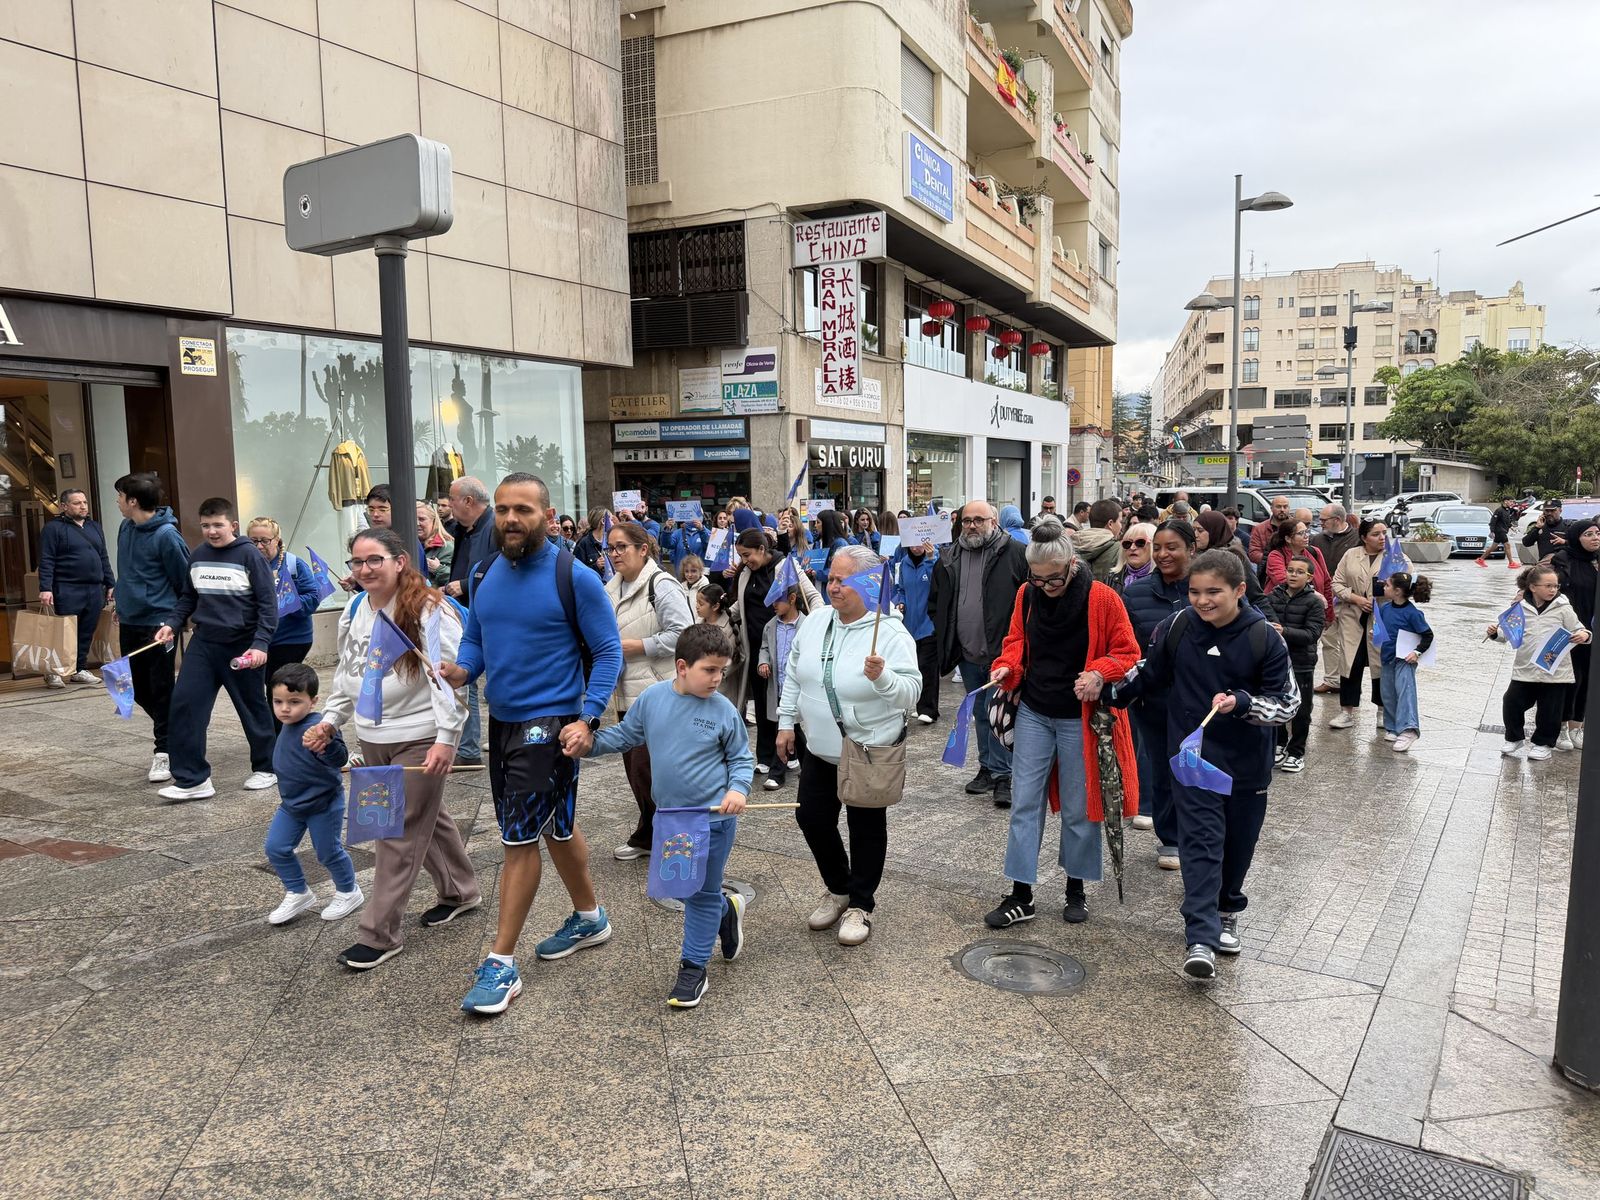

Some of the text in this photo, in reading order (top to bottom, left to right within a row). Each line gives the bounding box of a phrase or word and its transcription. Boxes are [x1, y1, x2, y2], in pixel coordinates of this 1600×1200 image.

[924, 168, 950, 200] DENTAL
[796, 215, 880, 243] Restaurante
[808, 238, 867, 262] CHINO
[822, 268, 836, 394] GRAN MURALLA
[836, 267, 856, 392] 长城酒楼
[724, 360, 743, 369] renfe
[724, 384, 758, 398] PLAZA
[617, 425, 657, 438] Lycamobile
[704, 448, 740, 458] Lycamobile
[818, 444, 882, 468] SAT GURU
[13, 642, 64, 674] ZARA
